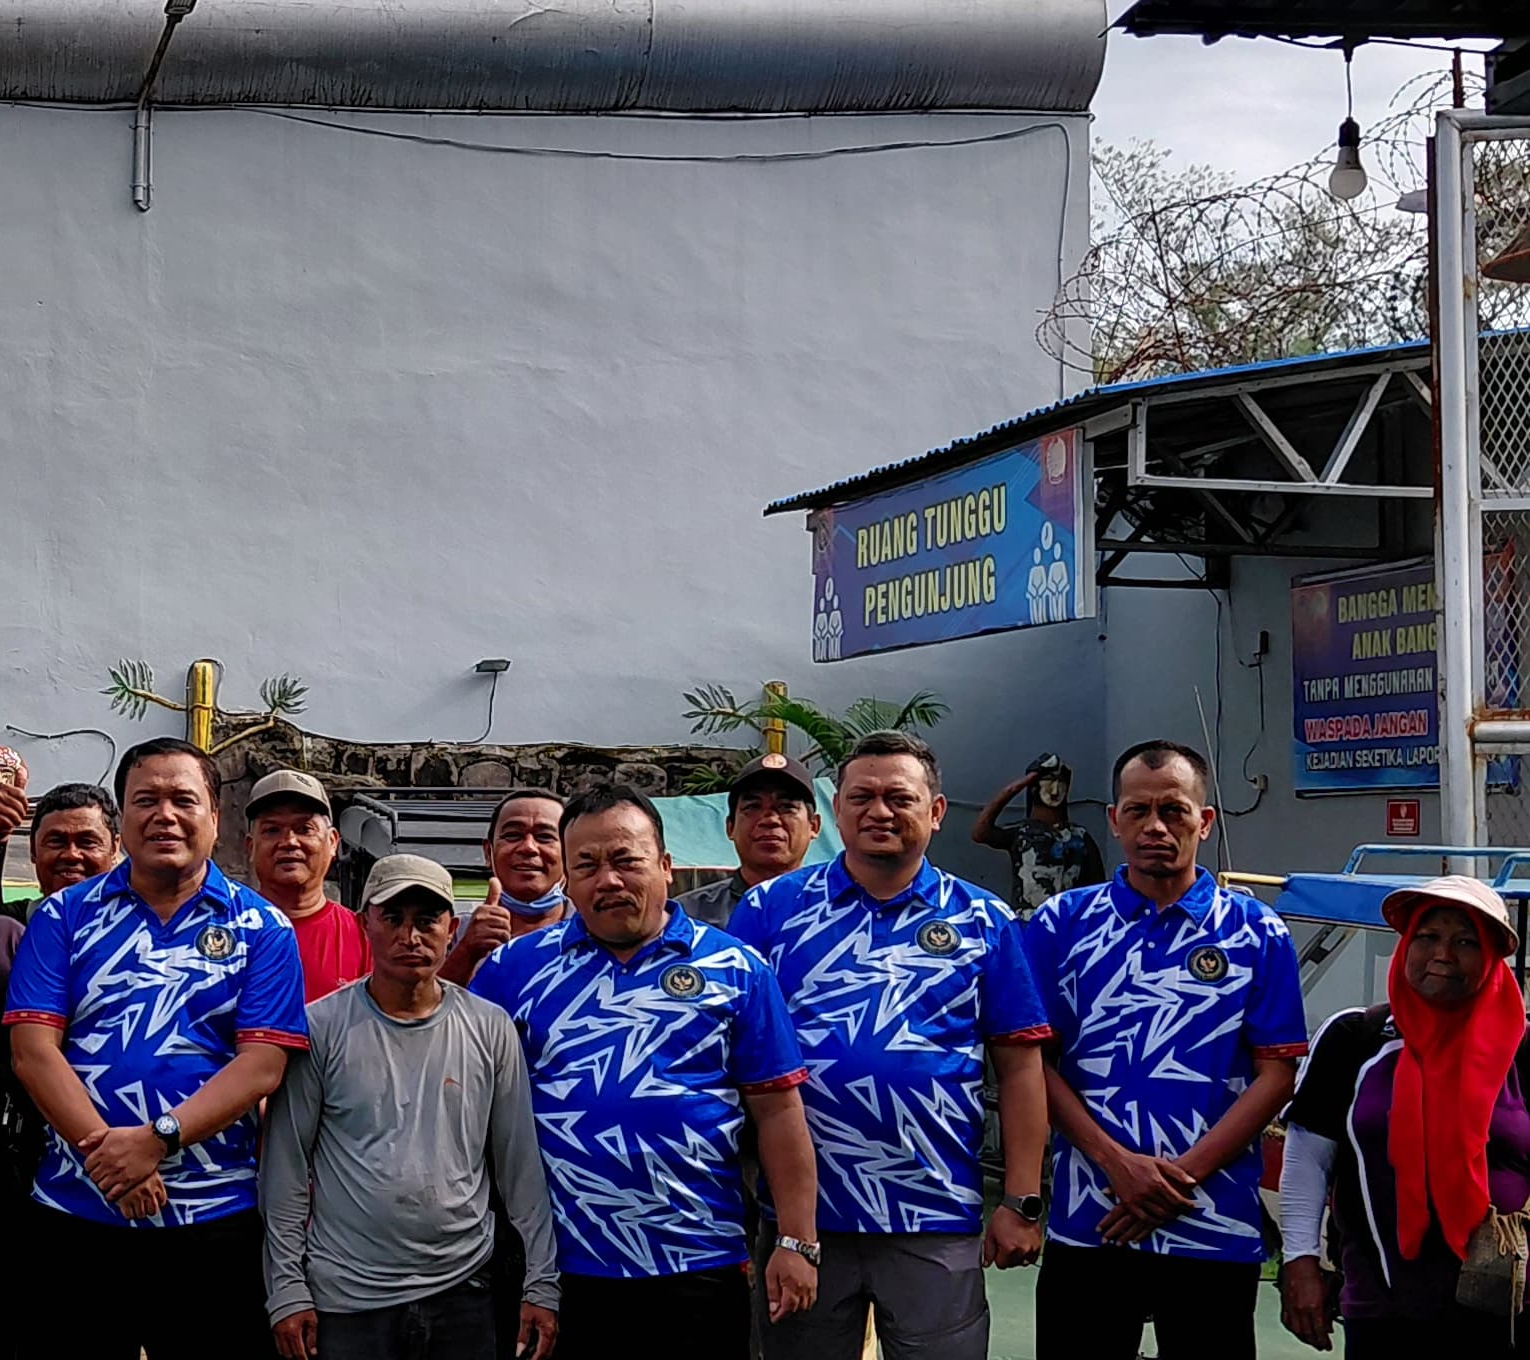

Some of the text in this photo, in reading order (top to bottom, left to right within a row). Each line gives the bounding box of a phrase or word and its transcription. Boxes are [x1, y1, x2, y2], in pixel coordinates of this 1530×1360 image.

[856, 484, 1007, 569] RUANG TUNGGU
[863, 556, 996, 627] PENGUNJUNG
[1337, 592, 1397, 623] BANGGA
[1352, 622, 1437, 660] ANAK BANG
[1303, 667, 1433, 703] TANPA MENGGUNAKAN
[1304, 709, 1428, 743] WASPADA JANGAN
[1306, 751, 1354, 770] KEJADIAN
[1355, 748, 1403, 768] SEKETIKA
